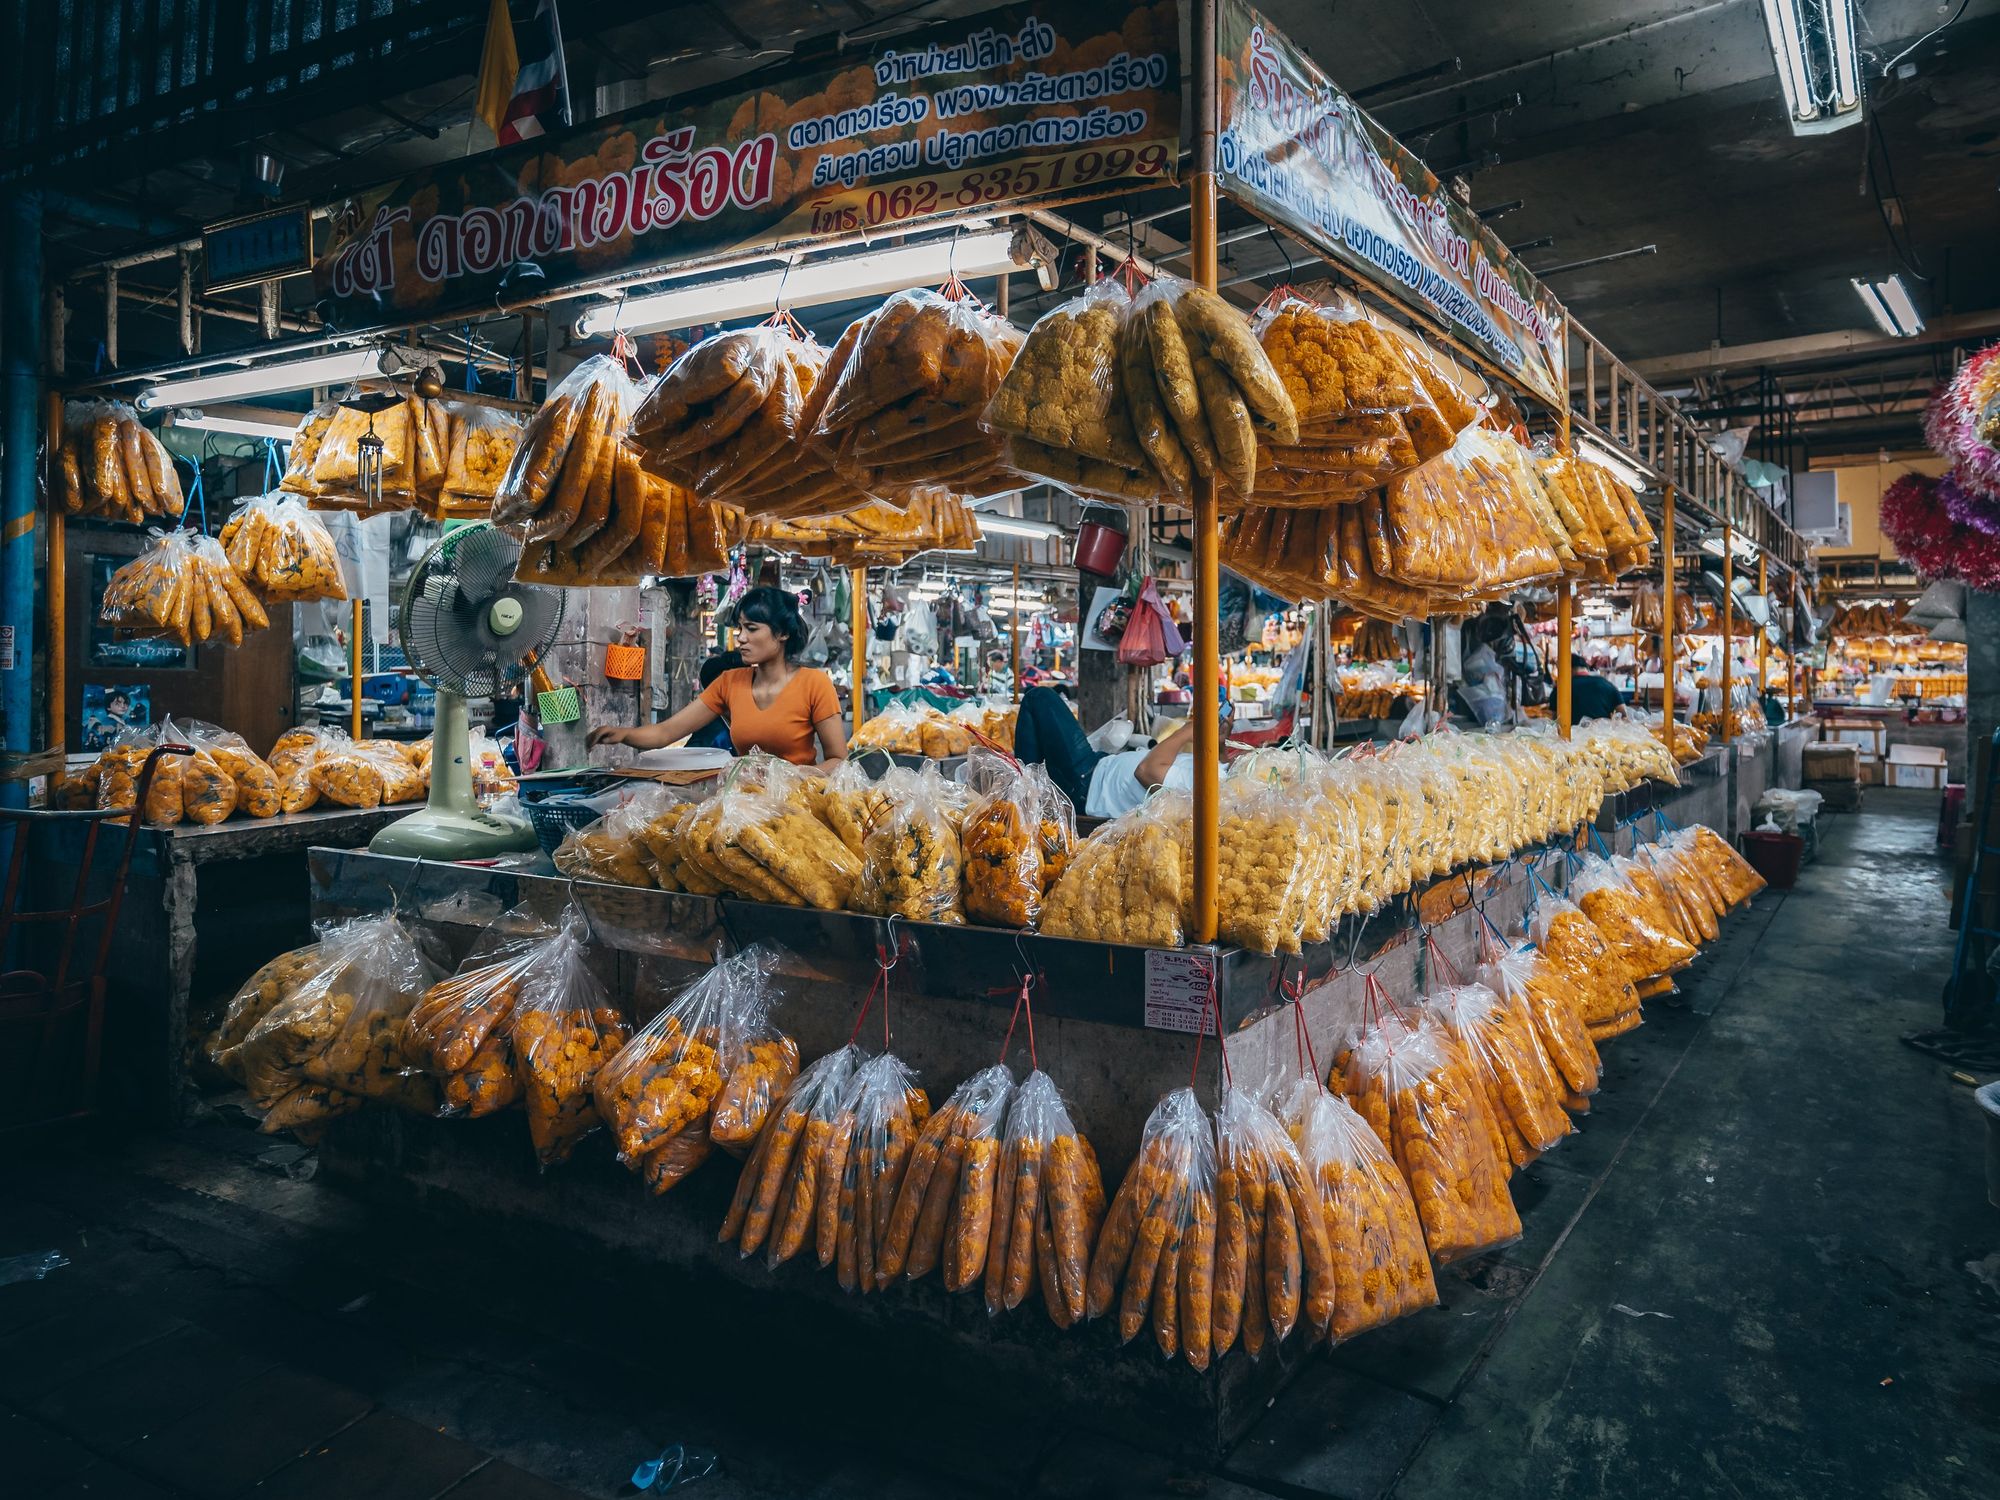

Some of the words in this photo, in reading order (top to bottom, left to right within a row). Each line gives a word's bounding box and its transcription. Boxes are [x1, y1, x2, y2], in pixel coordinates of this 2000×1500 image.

[874, 16, 1056, 86] จำหน่ายปลีก-ส่ง
[788, 89, 929, 150] ดอกดาวเรือง
[935, 52, 1168, 119] พวงมาลัยดาวเรือง
[812, 138, 920, 189] รับลูกสวน
[925, 106, 1148, 170] ปลูกดอกดาวเรือง
[416, 126, 778, 282] ดอกดาวเรือง
